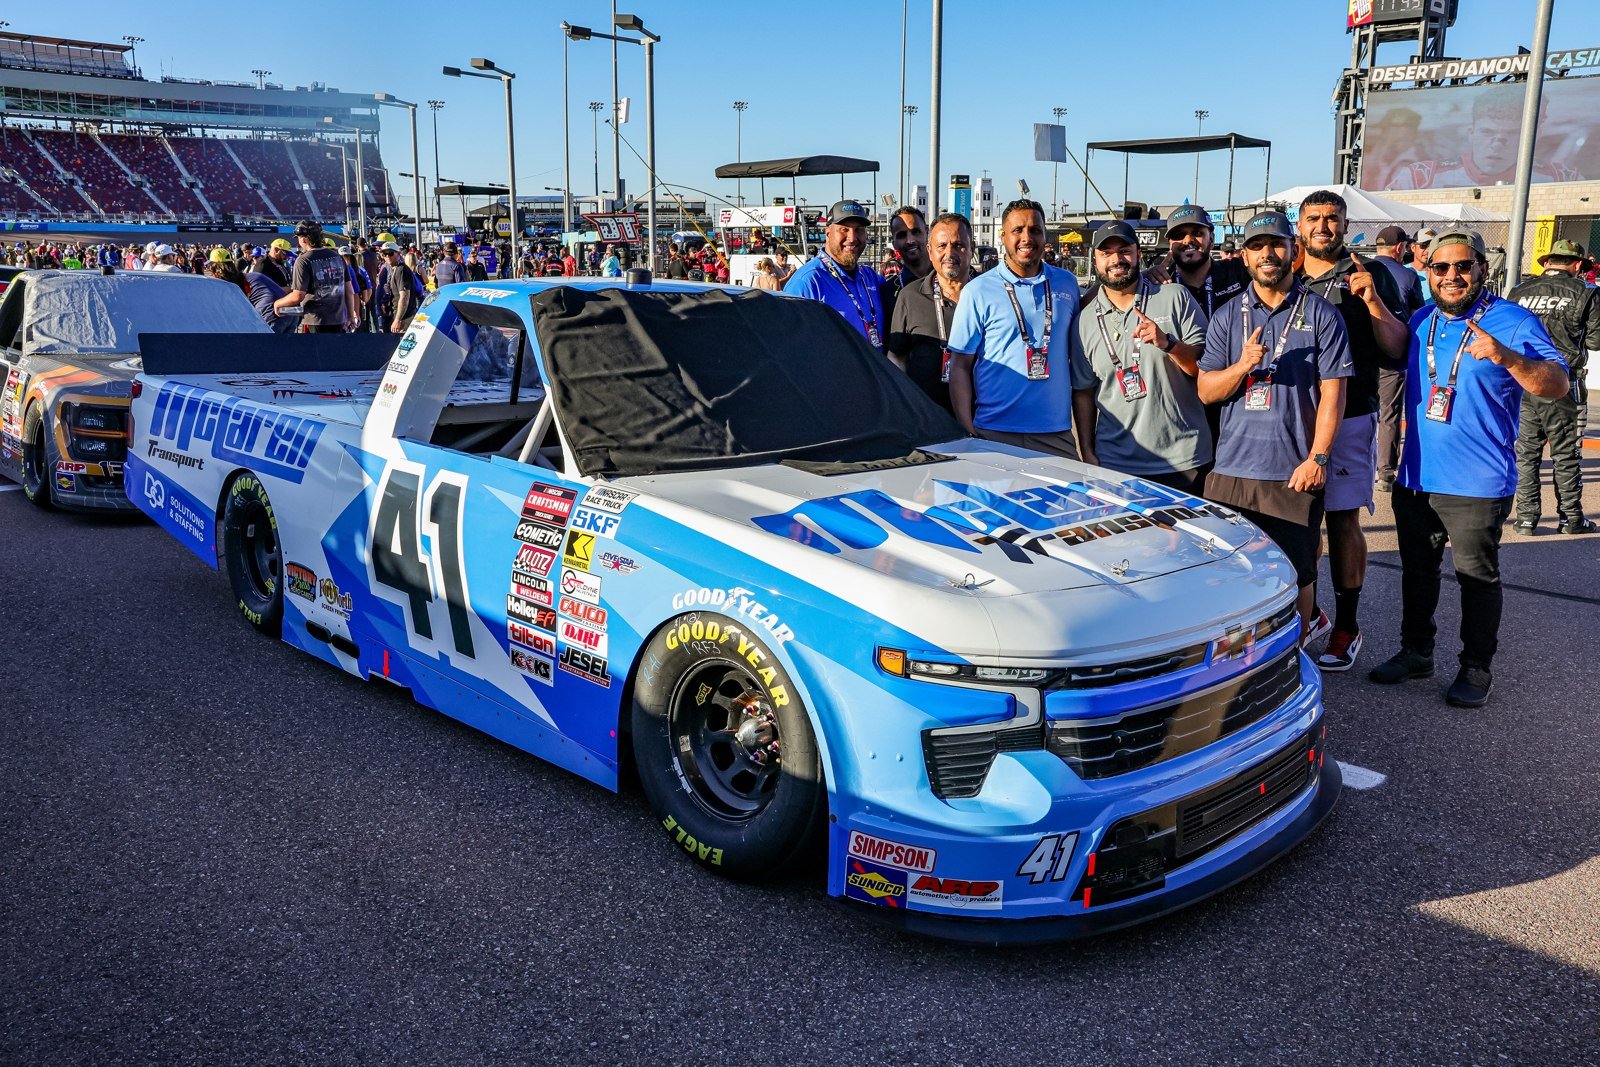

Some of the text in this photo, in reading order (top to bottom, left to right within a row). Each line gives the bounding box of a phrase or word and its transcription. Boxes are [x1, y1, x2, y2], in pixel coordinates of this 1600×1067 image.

[1370, 63, 1445, 84] DESERT
[1444, 55, 1531, 79] DIAMON
[149, 380, 327, 485] McLaren
[57, 461, 87, 472] ARP
[148, 439, 205, 471] Transport
[169, 495, 206, 531] SOLUTIONS
[527, 494, 570, 513] CRAFTSMAN
[585, 495, 623, 511] RACE TRUCK
[168, 508, 205, 543] & STAFFING
[516, 523, 563, 547] COMETIC
[571, 509, 619, 534] SKF
[370, 468, 477, 661] 41
[519, 548, 552, 570] KLOTZ
[563, 557, 589, 570] KENNAMETAL
[603, 552, 619, 562] FIVE
[619, 556, 635, 567] STAR
[513, 572, 547, 592] LINCOLN
[520, 586, 549, 603] WELDERS
[238, 599, 262, 625] EAGLE
[507, 595, 540, 624] Holley
[559, 597, 607, 626] CALICO
[671, 586, 796, 646] GOODYEAR
[509, 623, 553, 655] tilton
[560, 645, 611, 681] JESEL
[665, 619, 791, 709] GOODYEAR
[662, 814, 724, 866] EAGLE
[852, 833, 931, 870] SIMPSON
[1015, 830, 1081, 886] 41
[848, 873, 905, 897] SUNOCO
[910, 875, 1000, 897] ARP
[910, 889, 950, 900] automotive
